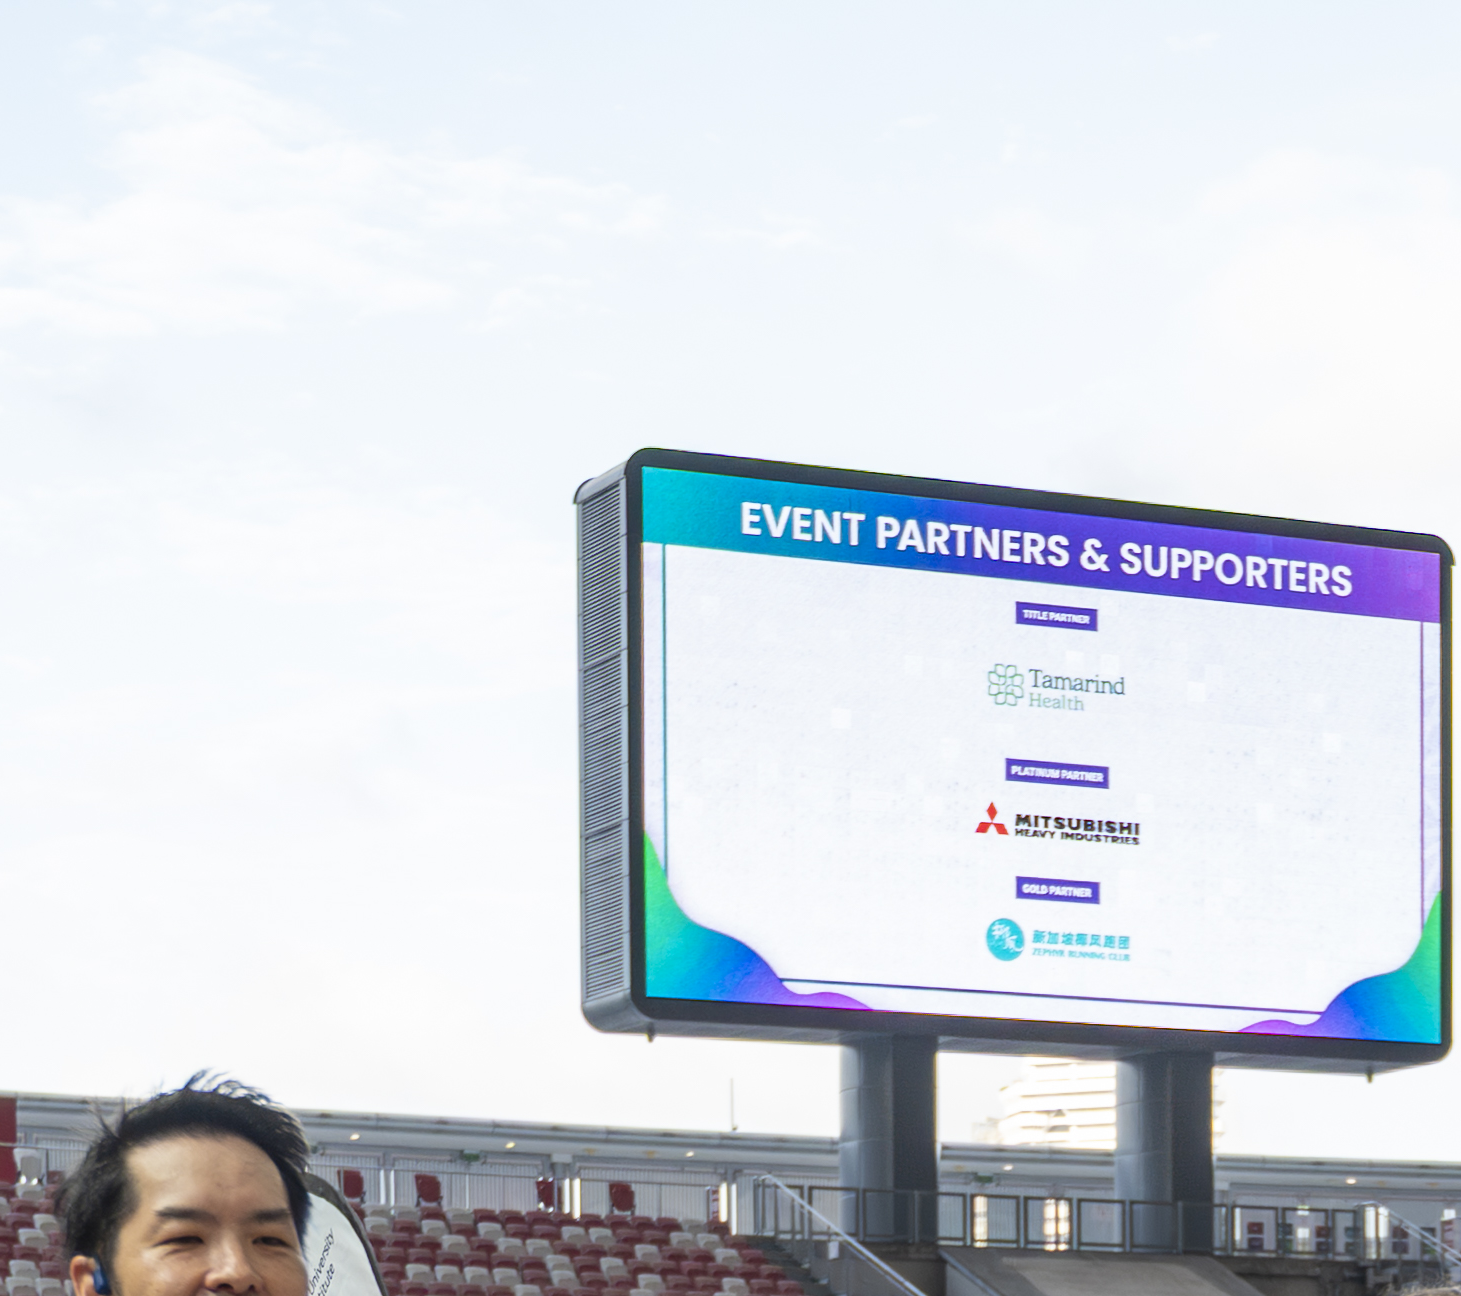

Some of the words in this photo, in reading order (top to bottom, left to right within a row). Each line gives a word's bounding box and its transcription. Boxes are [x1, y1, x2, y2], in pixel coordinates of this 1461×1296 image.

[741, 501, 866, 546] EVENT
[875, 515, 1070, 567] PARTNERS
[1079, 538, 1111, 573] &
[1119, 541, 1353, 597] SUPPORTERS
[1022, 609, 1048, 621] TITLE
[1049, 611, 1091, 625] PARTNER
[1028, 668, 1126, 695] Tamarind
[1028, 692, 1085, 711] Health
[1010, 765, 1060, 779] PLATINUM
[1060, 769, 1104, 782] PARTNER
[1014, 814, 1140, 836] MITSUBISHI
[1014, 828, 1056, 840] HEAVY
[1060, 831, 1140, 846] INDUSTRIES
[1021, 883, 1048, 895] GOLD
[1049, 885, 1093, 898] PARTNER
